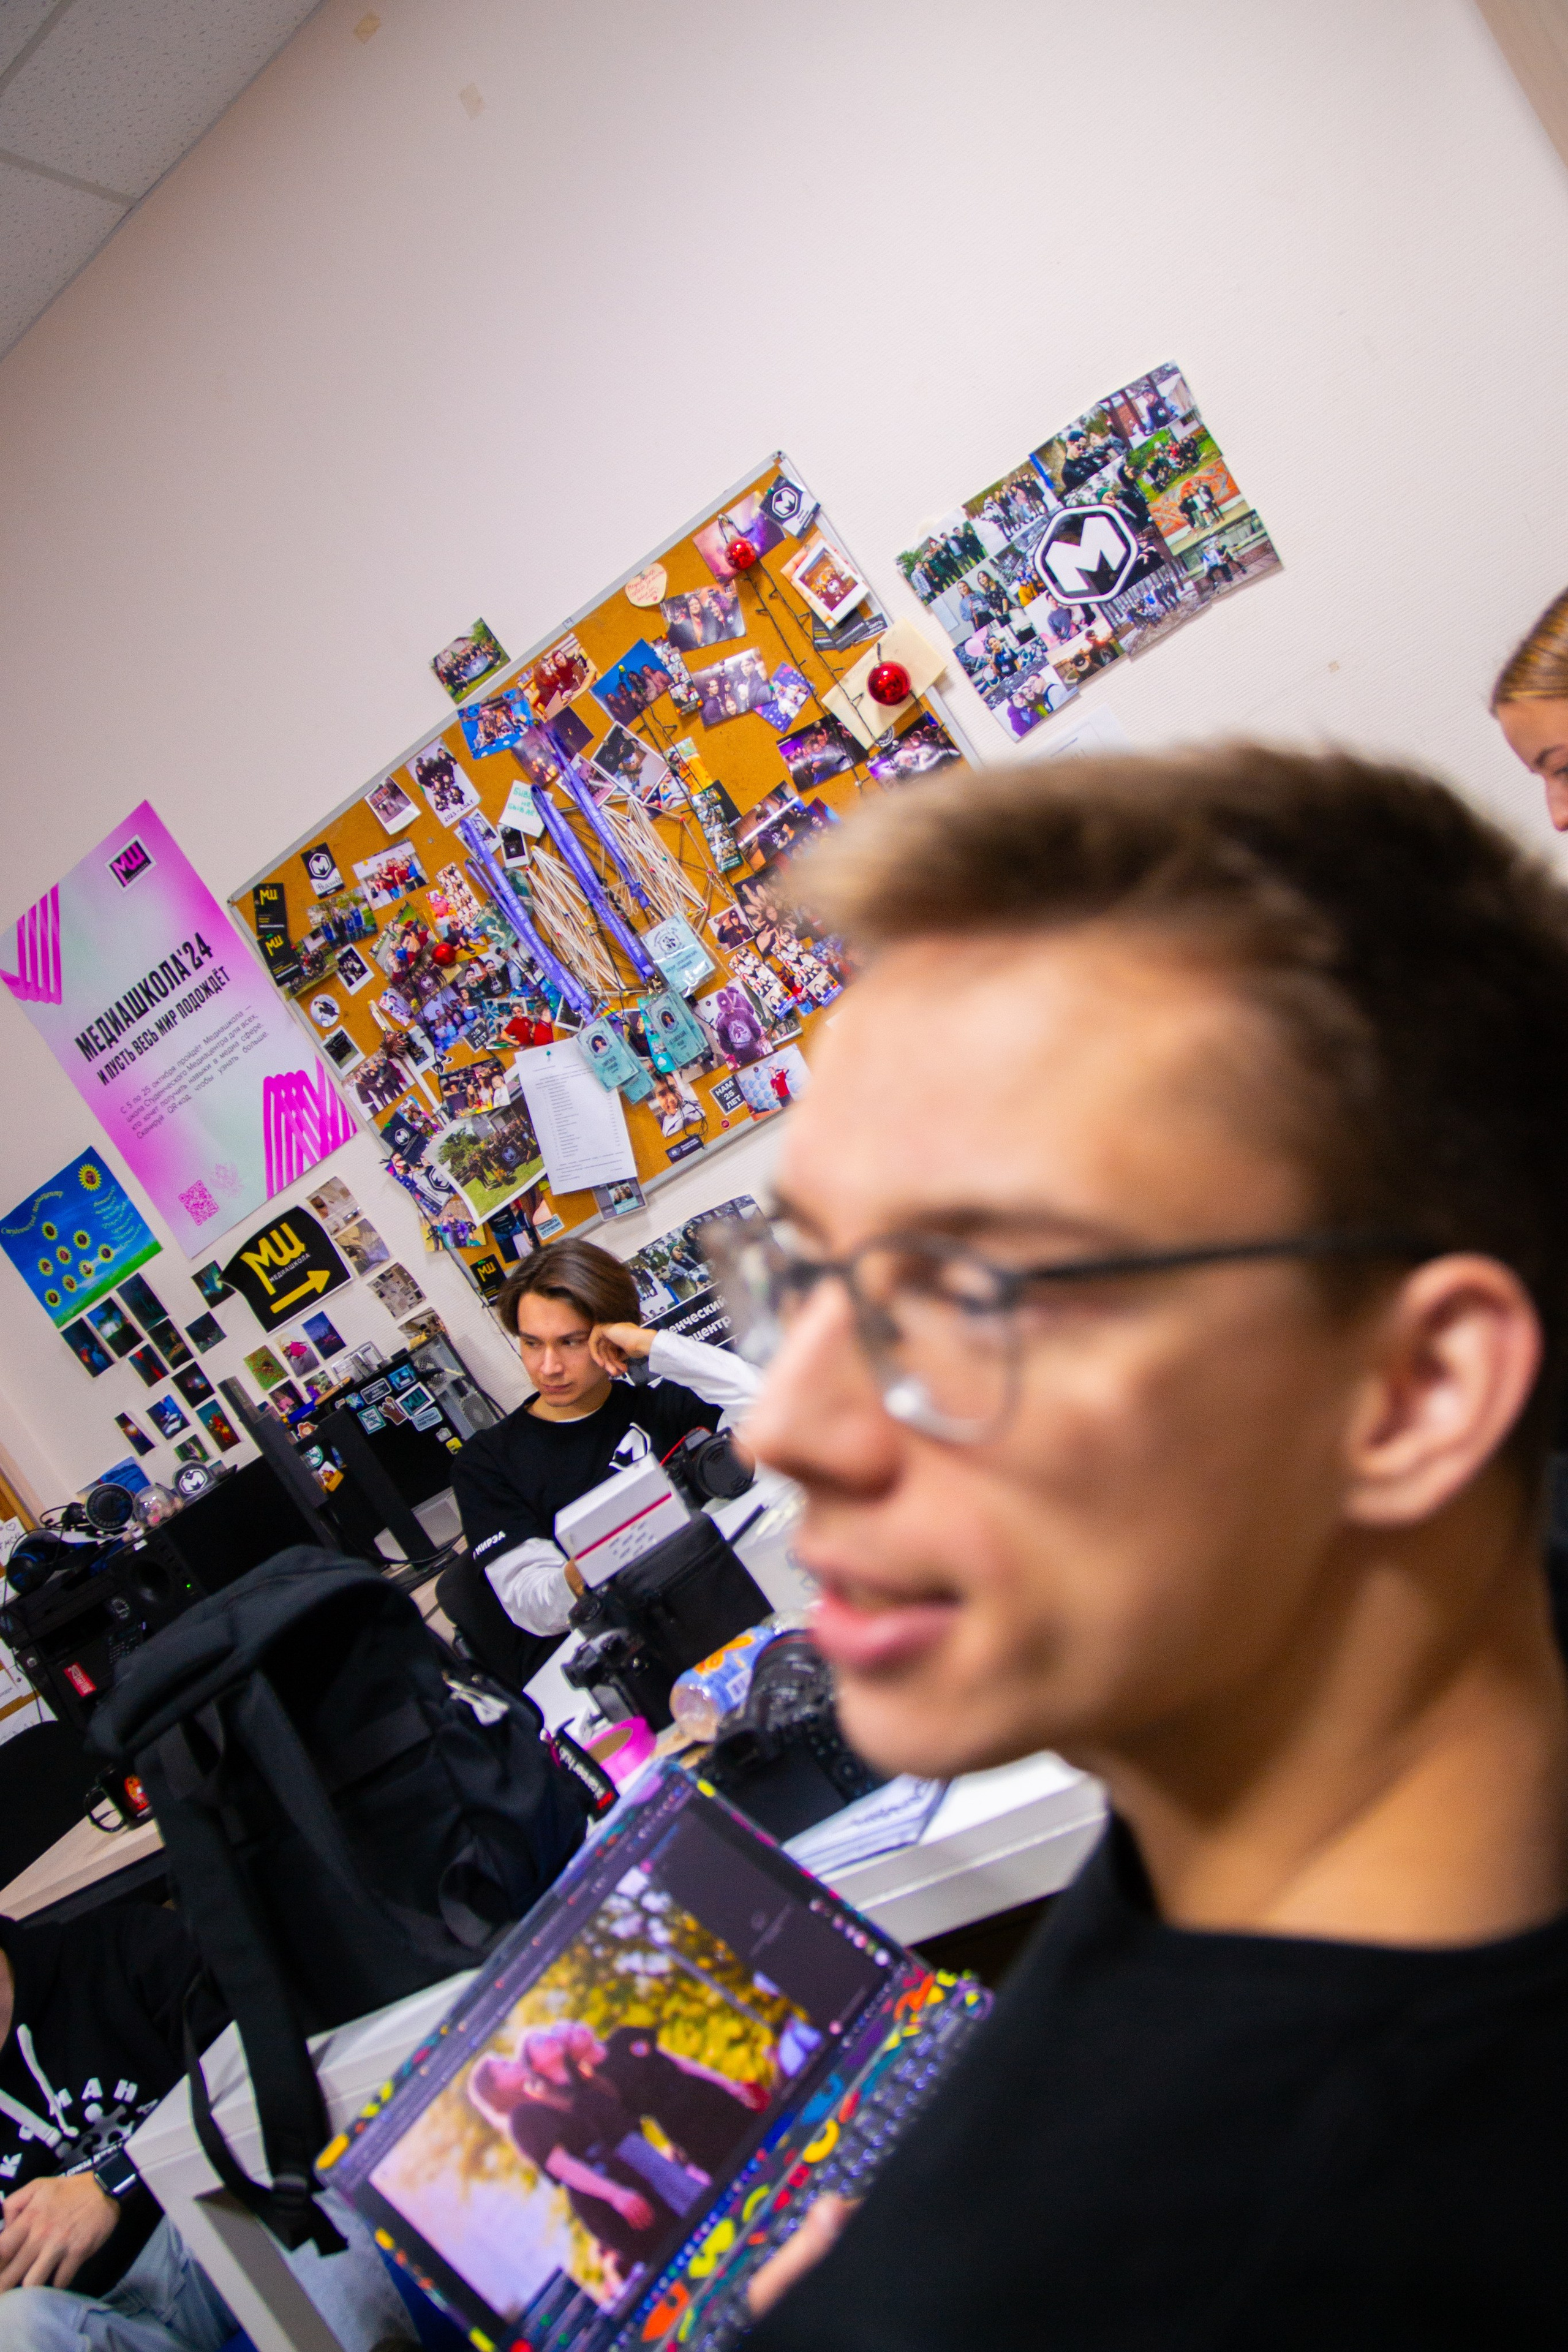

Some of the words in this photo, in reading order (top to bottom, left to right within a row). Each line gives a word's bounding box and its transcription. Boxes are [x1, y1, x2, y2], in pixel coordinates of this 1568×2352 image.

[74, 932, 213, 1062] МЕДИАШКОЛА'24
[97, 1069, 109, 1085] И
[103, 1046, 136, 1079] ПУСТЬ
[130, 1027, 159, 1055] ВЕСЬ
[154, 1009, 178, 1036] МИР
[175, 963, 231, 1019] ПОДОЖДЁТ
[141, 1085, 151, 1096] 25
[151, 1065, 176, 1088] октября
[176, 1043, 202, 1068] пройдёт
[203, 1010, 244, 1046] Медиашкола
[124, 1104, 145, 1123] школа
[143, 1069, 188, 1109] Студенческого
[186, 1036, 229, 1072] Медиацентра
[227, 1026, 241, 1039] для
[142, 1106, 160, 1123] хочет
[159, 1084, 188, 1108] получить
[187, 1063, 211, 1084] навыки
[218, 1040, 239, 1059] медиа
[193, 1073, 214, 1092] чтобы
[217, 1055, 239, 1074] узнать
[715, 1080, 734, 1096] НАМ
[723, 1090, 735, 1100] 25
[726, 1095, 741, 1109] ЛЕТ
[239, 1222, 304, 1295] МШ
[269, 1252, 310, 1283] МЕДИАШКОЛА
[666, 1294, 727, 1334] енческий
[475, 1530, 506, 1555] МИРЭА
